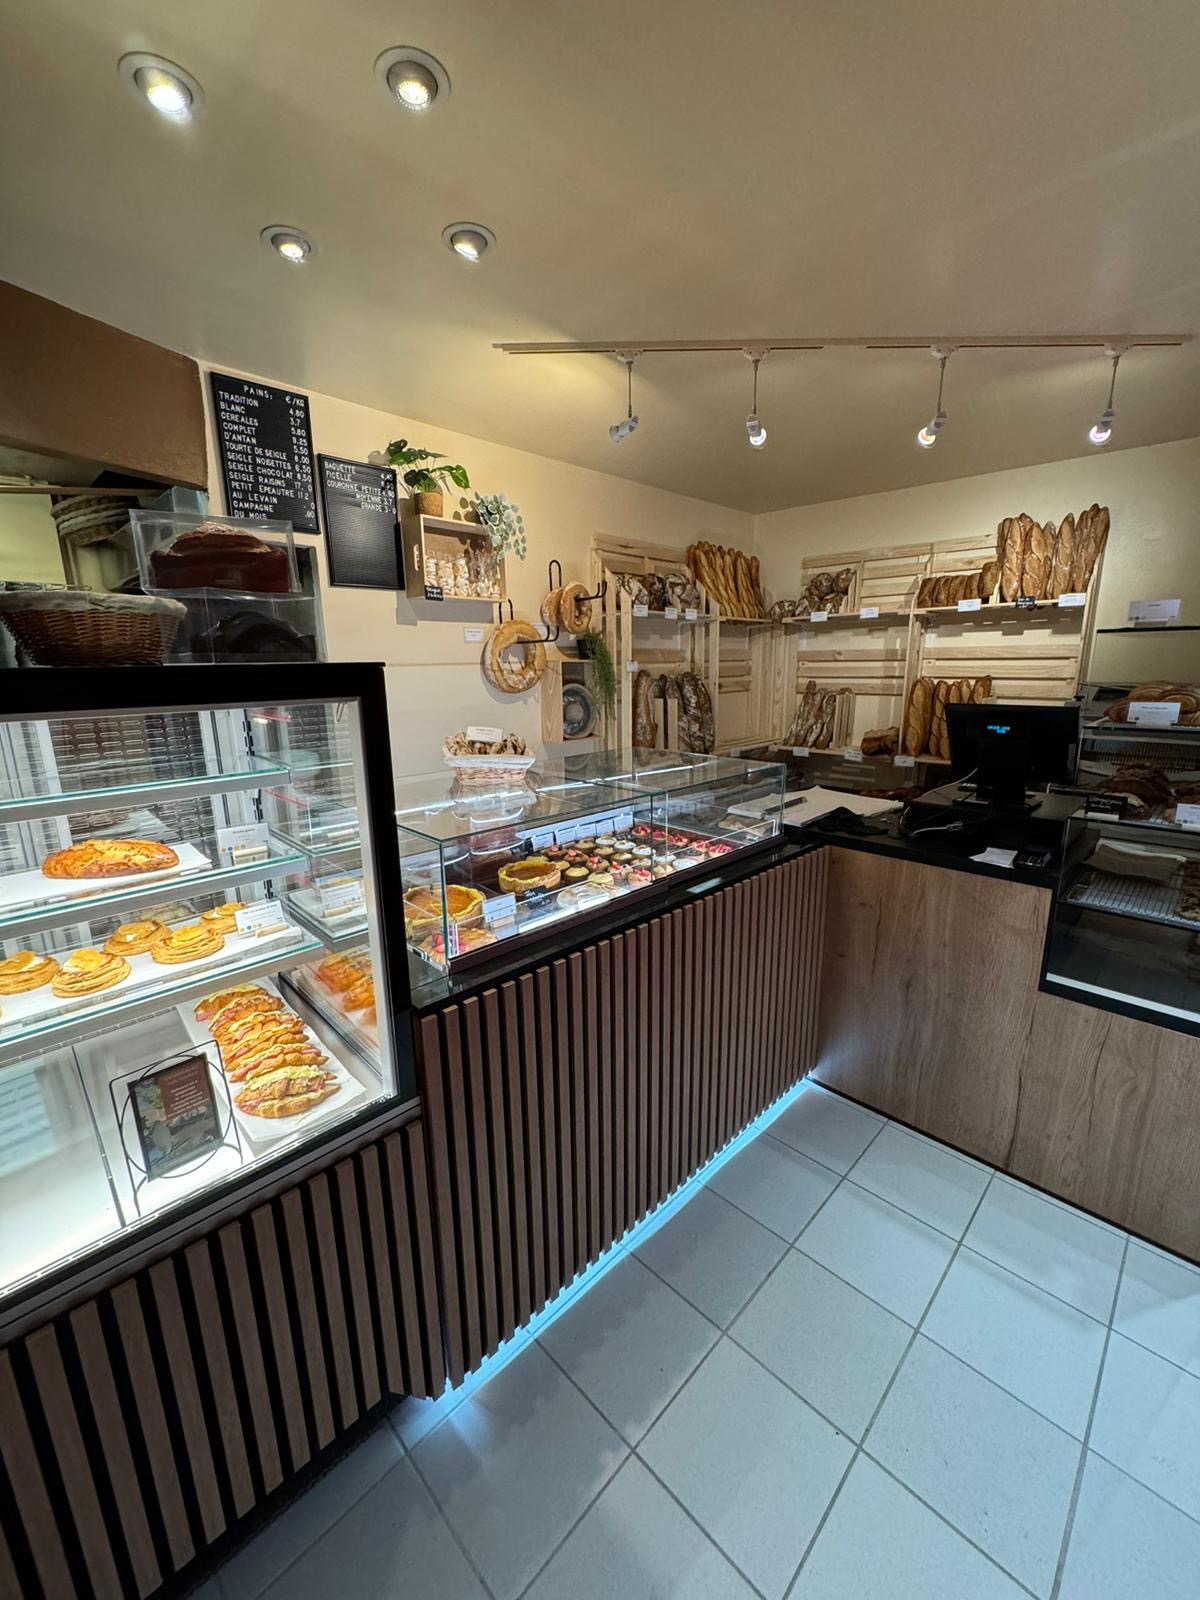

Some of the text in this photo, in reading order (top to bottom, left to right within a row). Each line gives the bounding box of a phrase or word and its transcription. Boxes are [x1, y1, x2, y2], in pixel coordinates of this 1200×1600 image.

[218, 391, 258, 407] TRADITION
[220, 401, 245, 414] BLANC
[221, 412, 258, 426] CEREALES
[223, 422, 256, 435] COMPLET
[224, 432, 256, 445] D'ANTAN
[226, 442, 252, 453] TOURTE
[254, 447, 263, 456] DE
[265, 450, 287, 460] SEIGLE
[227, 452, 252, 463] SEIGLE
[256, 457, 291, 470] NOISETTES
[324, 461, 356, 474] BAGUETTE
[228, 462, 253, 472] SEIGLE
[257, 467, 293, 479] CHOCOLAT
[326, 470, 352, 482] FICELLE
[229, 472, 254, 482] SEIGLE
[258, 476, 286, 487] RAISINS
[232, 481, 252, 491] PETIT
[259, 485, 295, 498] EPEAUTRE
[327, 480, 358, 492] COURONNE
[362, 485, 382, 496] PETITE
[232, 491, 243, 499] AU
[248, 493, 278, 504] LEVAIN
[356, 493, 382, 504] MOYENNE
[233, 500, 274, 512] CAMPAGNE
[361, 502, 382, 512] GRANDE
[234, 510, 267, 520] DU MOIS
